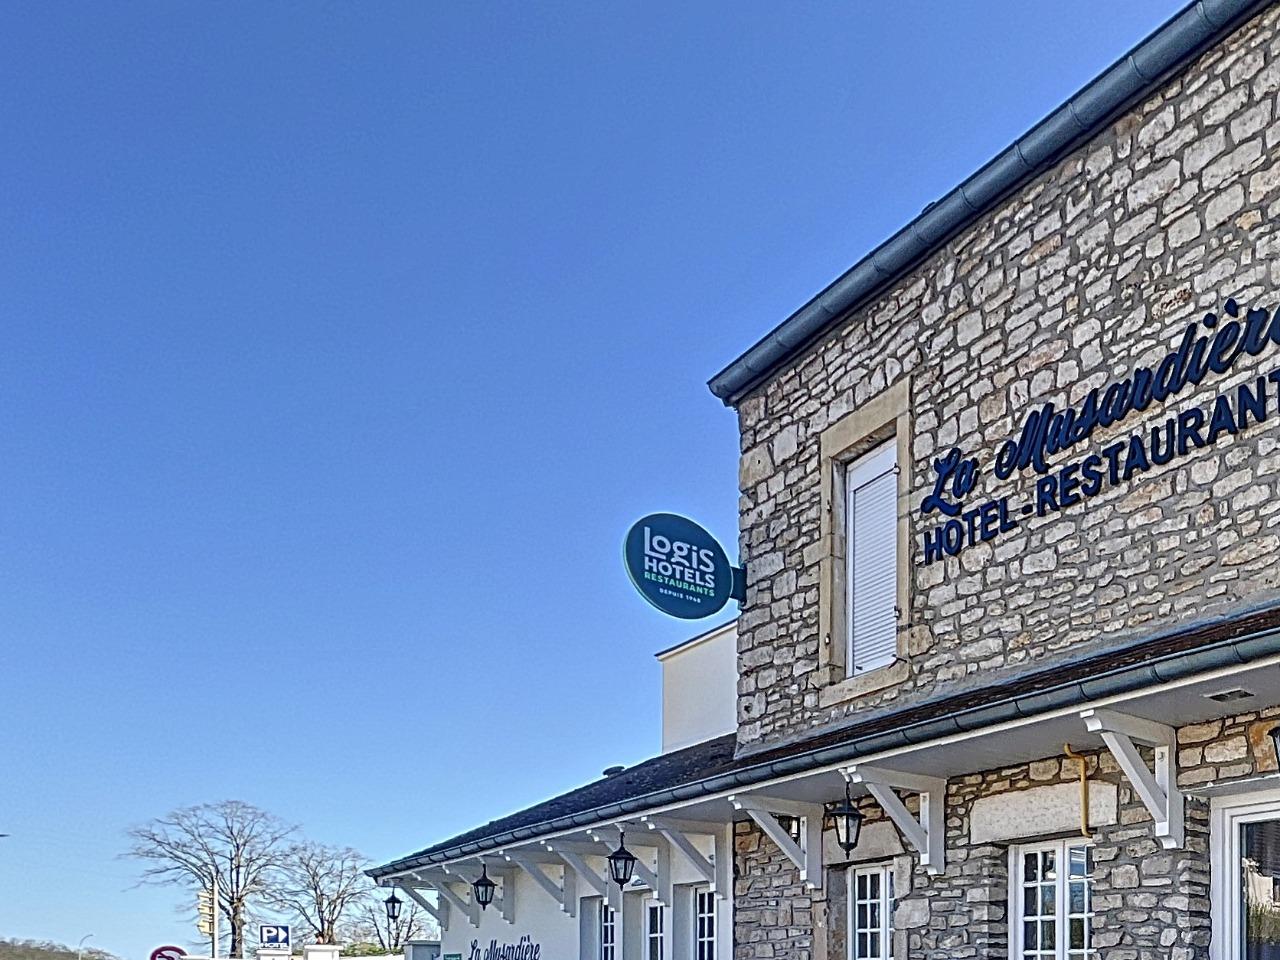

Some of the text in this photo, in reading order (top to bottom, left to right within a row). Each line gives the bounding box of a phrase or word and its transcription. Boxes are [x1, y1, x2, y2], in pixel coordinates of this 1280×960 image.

[921, 448, 980, 516] La
[644, 556, 715, 588] HOTELS
[644, 571, 715, 597] RESTAURANTS
[262, 926, 278, 942] P
